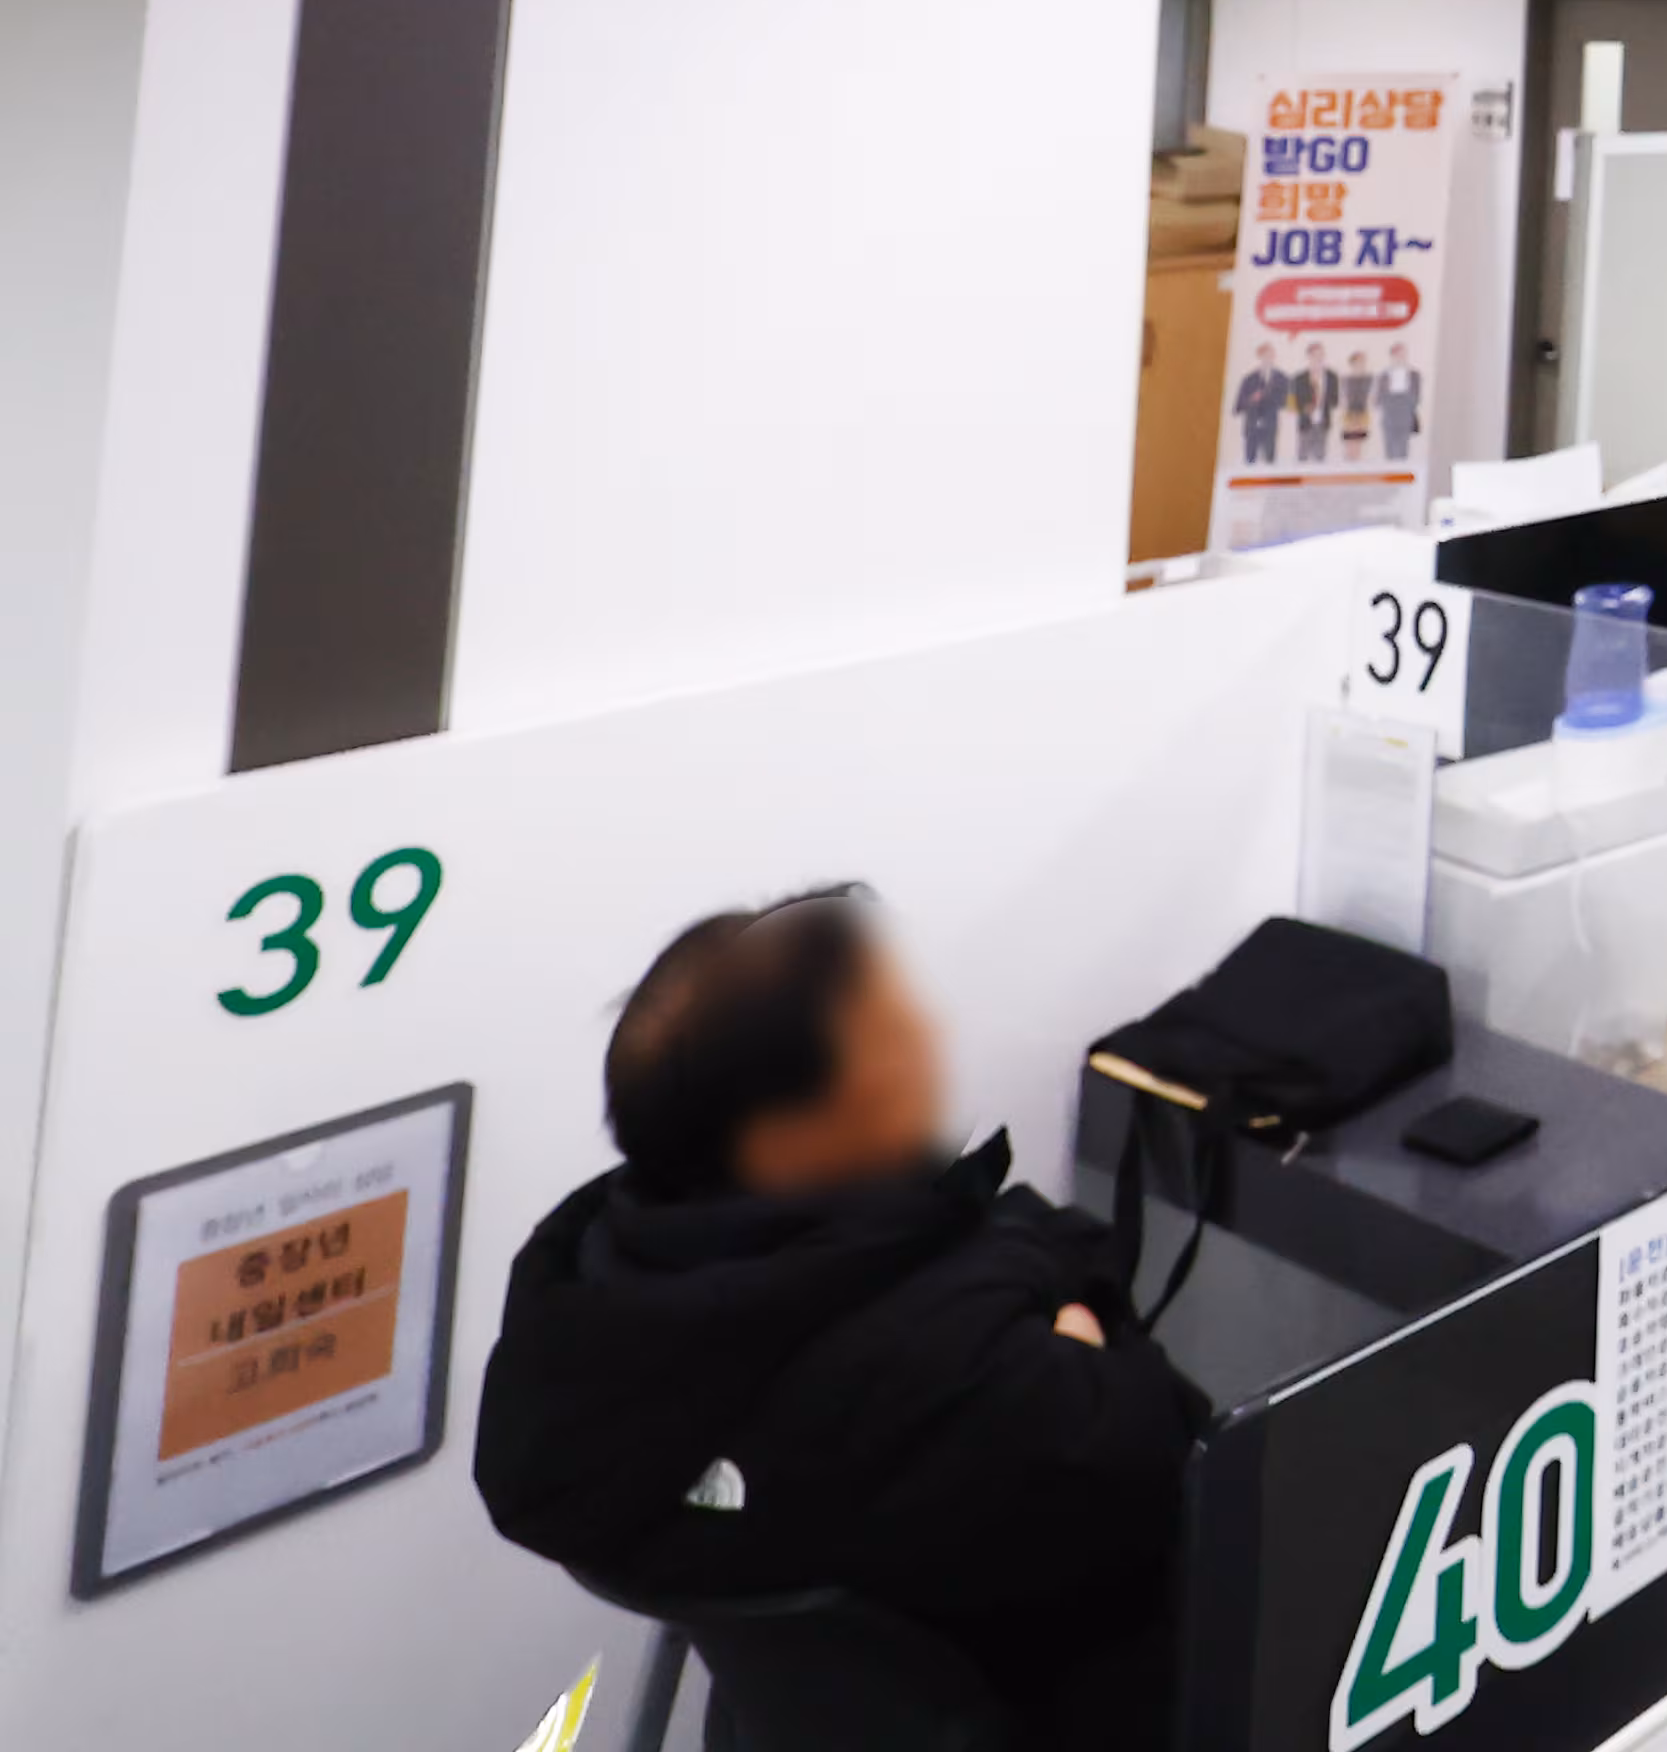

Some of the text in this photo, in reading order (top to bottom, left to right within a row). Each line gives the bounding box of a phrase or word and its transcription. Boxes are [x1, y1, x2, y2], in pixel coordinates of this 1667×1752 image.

[1268, 88, 1445, 132] 심리상담
[1256, 182, 1348, 222] 희망
[1252, 228, 1342, 268] JOB
[1366, 592, 1449, 693] 39
[216, 845, 443, 1017] 39
[1338, 1388, 1596, 1736] 40
